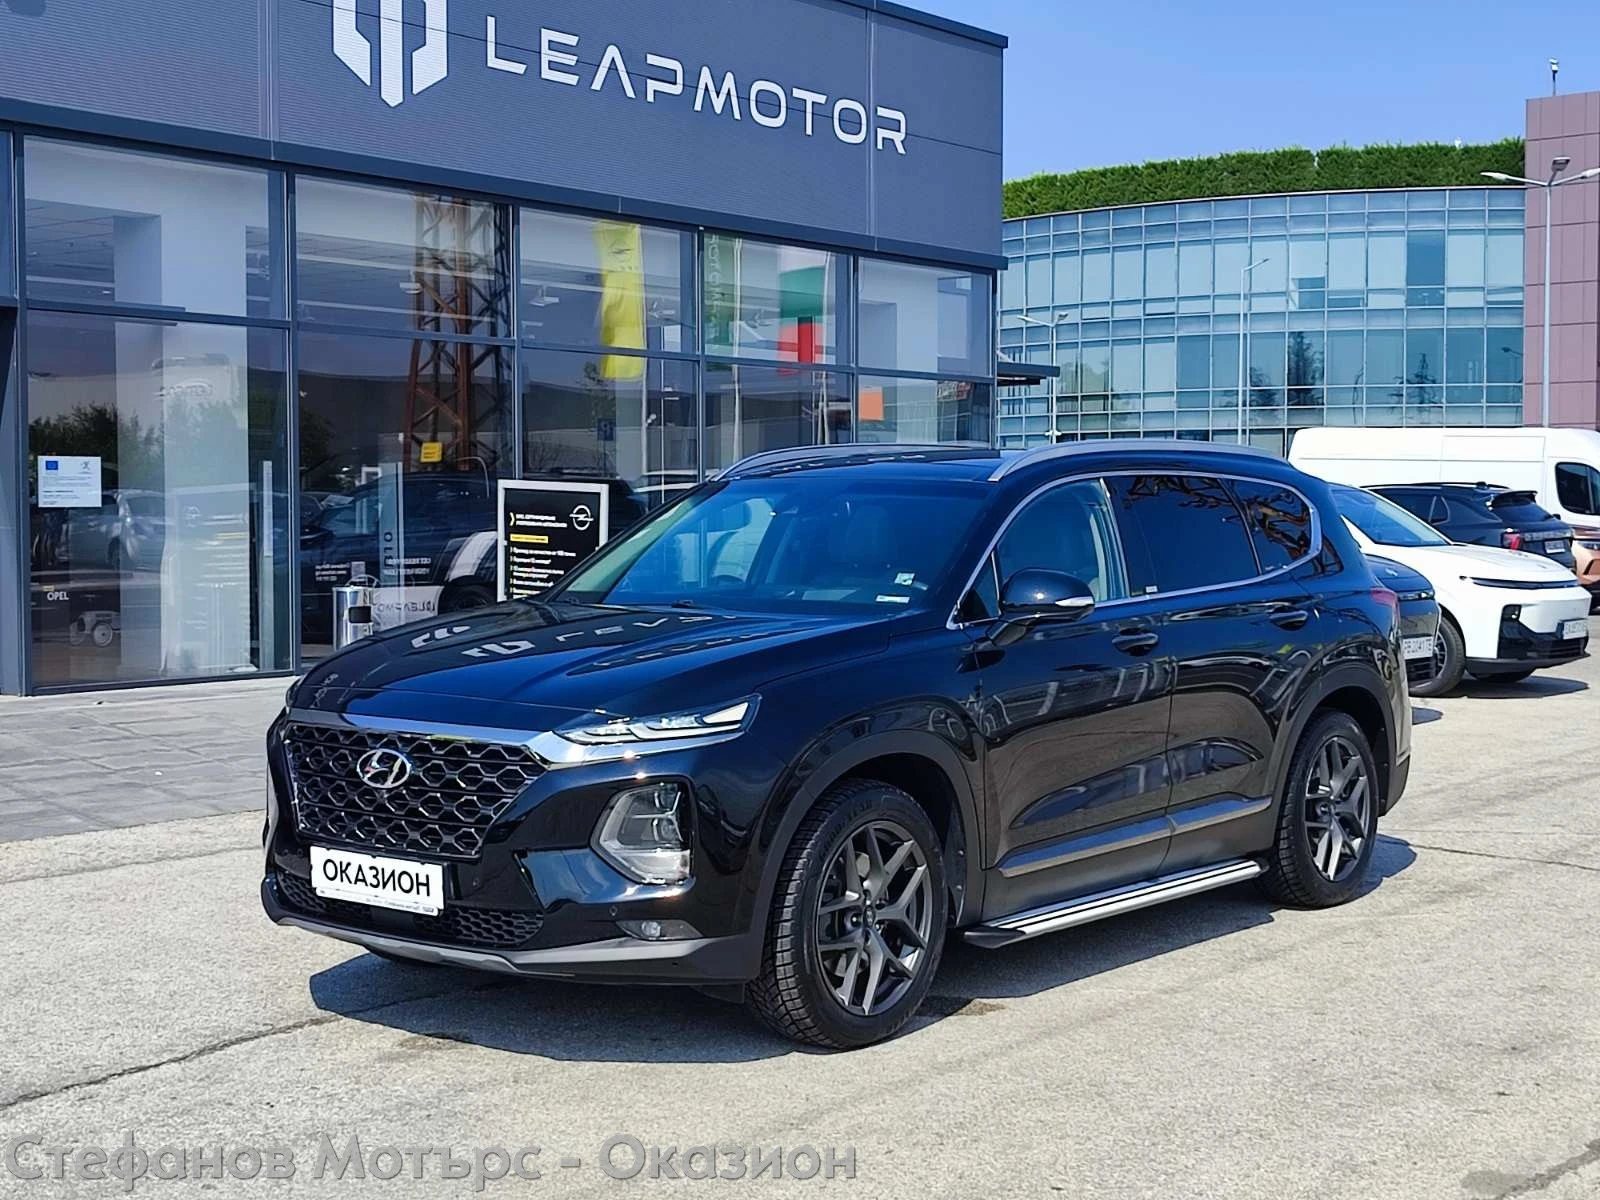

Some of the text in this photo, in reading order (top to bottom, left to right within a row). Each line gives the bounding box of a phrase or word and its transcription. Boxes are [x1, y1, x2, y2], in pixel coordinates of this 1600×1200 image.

[486, 15, 907, 154] LEAPMOTOR
[47, 591, 70, 601] OPEL
[323, 858, 430, 896] ОКАЗИОН
